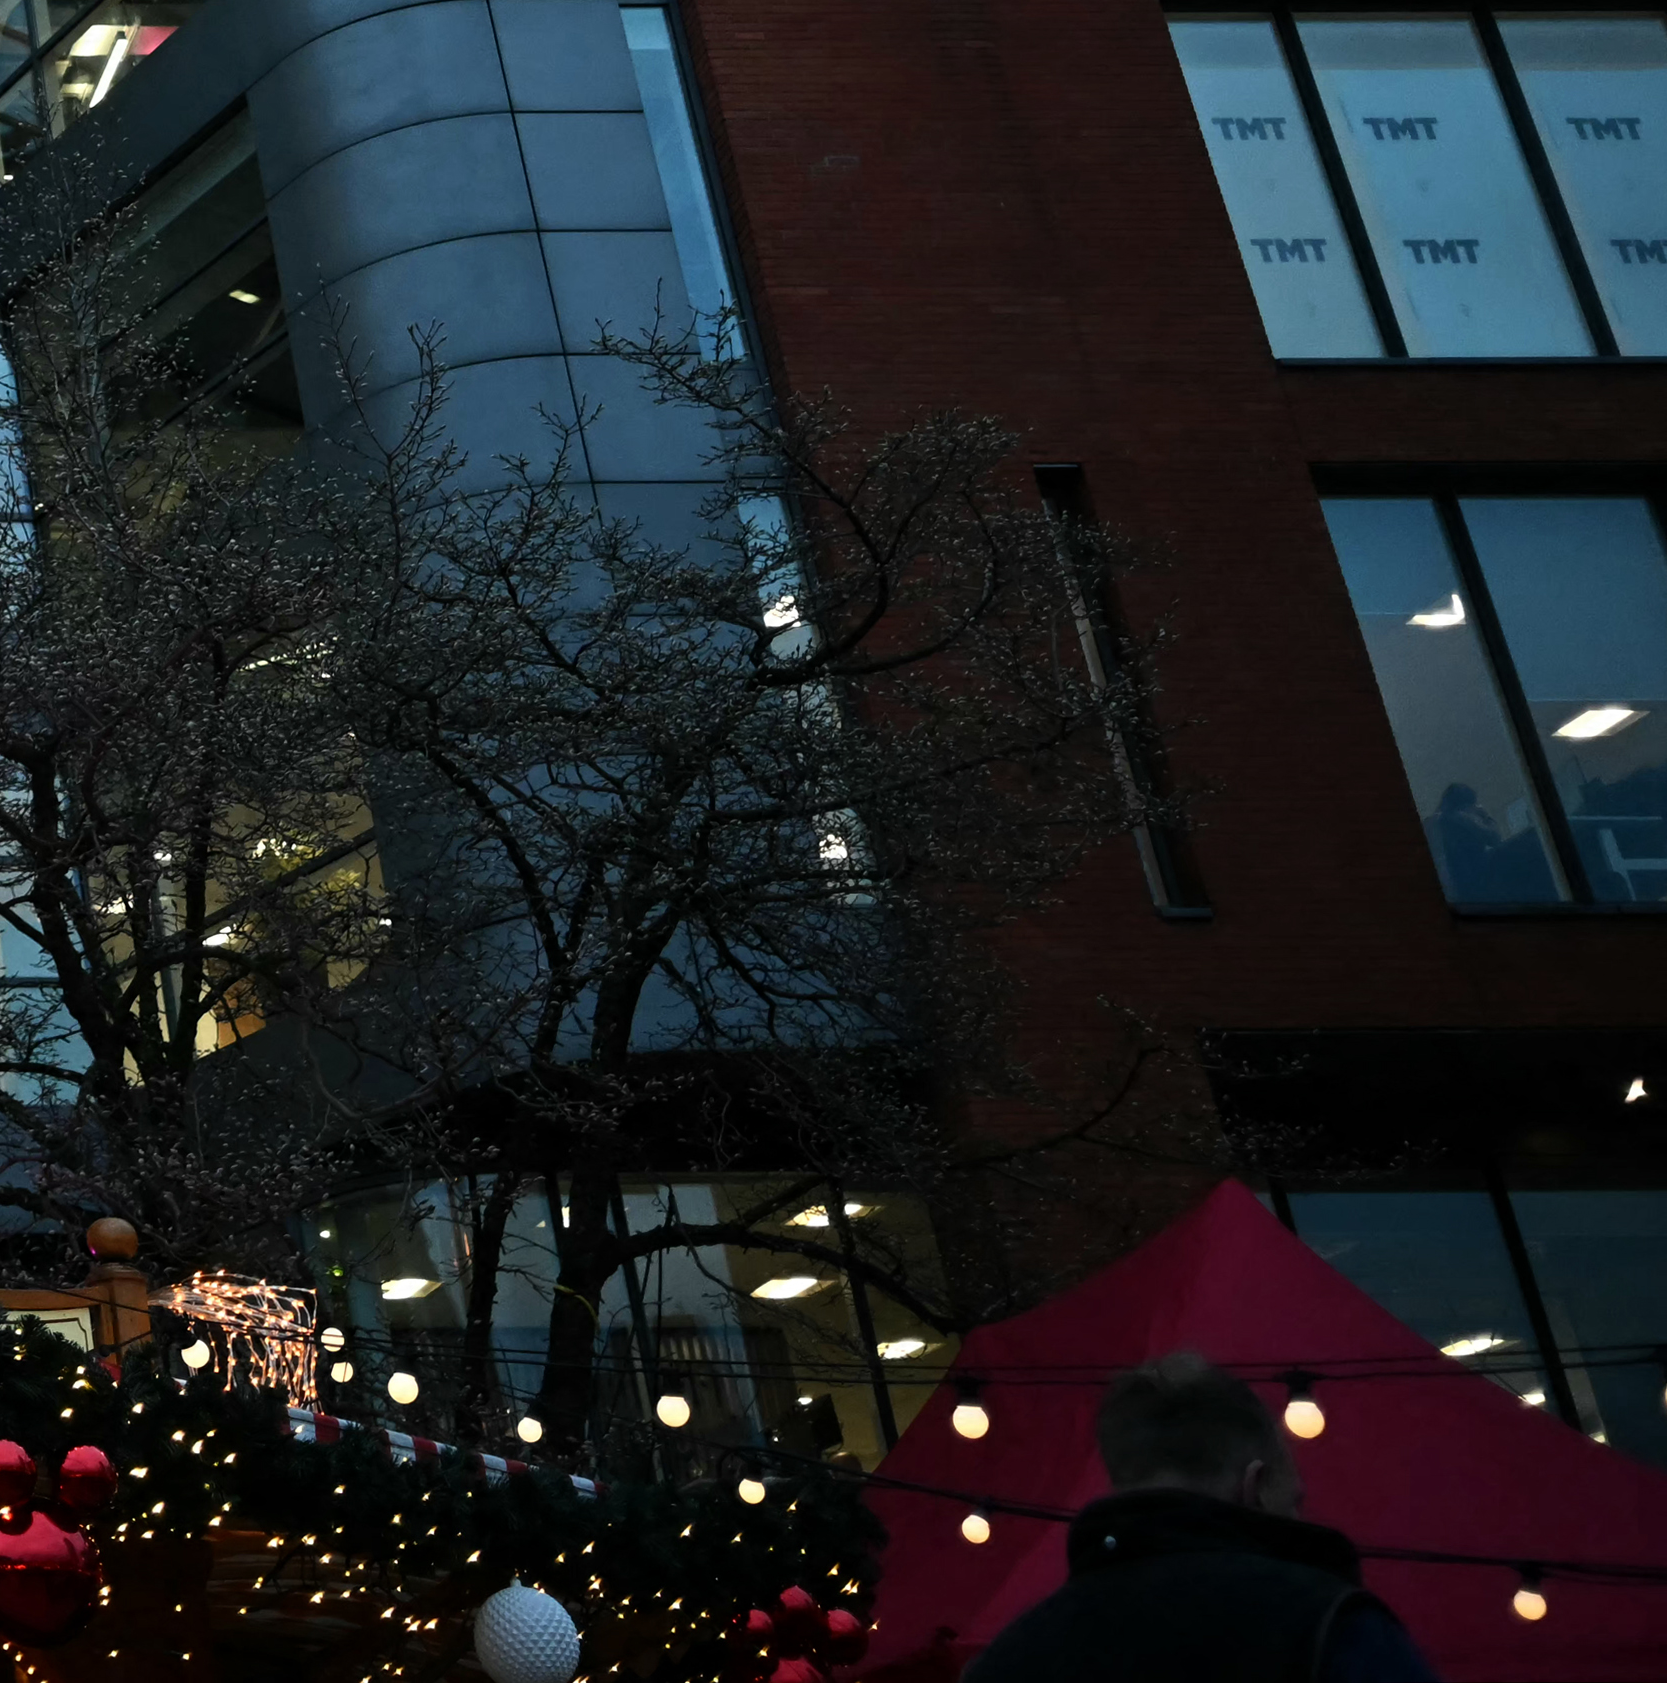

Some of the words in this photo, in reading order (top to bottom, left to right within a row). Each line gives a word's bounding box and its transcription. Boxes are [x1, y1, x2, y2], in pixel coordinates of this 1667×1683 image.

[1211, 117, 1286, 140] TMT
[1362, 117, 1437, 140] TMT
[1566, 117, 1641, 140] TMT
[1250, 238, 1327, 263] TMT
[1402, 239, 1479, 264] TMT
